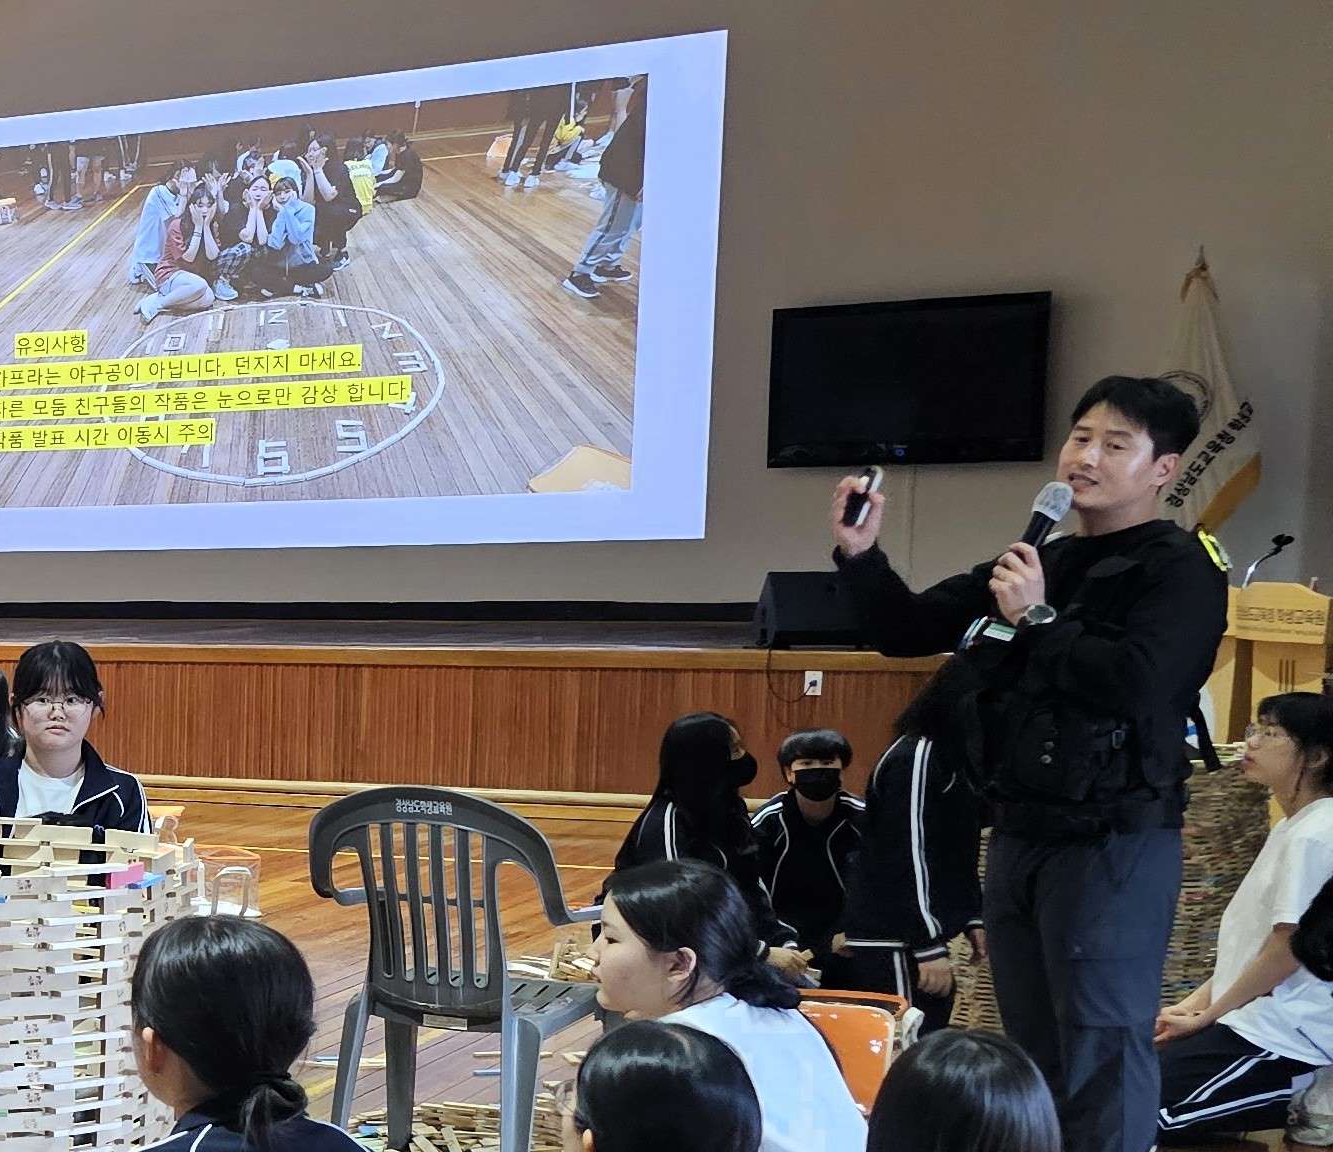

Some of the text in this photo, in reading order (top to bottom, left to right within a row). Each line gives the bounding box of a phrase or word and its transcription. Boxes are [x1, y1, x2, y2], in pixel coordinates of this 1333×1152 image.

[16, 334, 86, 356] 유의사항
[69, 362, 140, 384] 야구공이
[149, 357, 226, 380] 아닙니다,
[235, 353, 289, 375] 던지지
[300, 351, 361, 370] 마세요.
[33, 398, 67, 417] 모둠
[75, 394, 146, 416] 친구들의
[154, 391, 208, 412] 작품은
[217, 387, 291, 409] 눈으로만
[301, 385, 338, 404] 감상
[347, 381, 411, 402] 합니다.
[32, 430, 66, 447] 발표
[75, 428, 109, 447] 시간
[117, 425, 169, 445] 이동시
[178, 423, 213, 442] 주의
